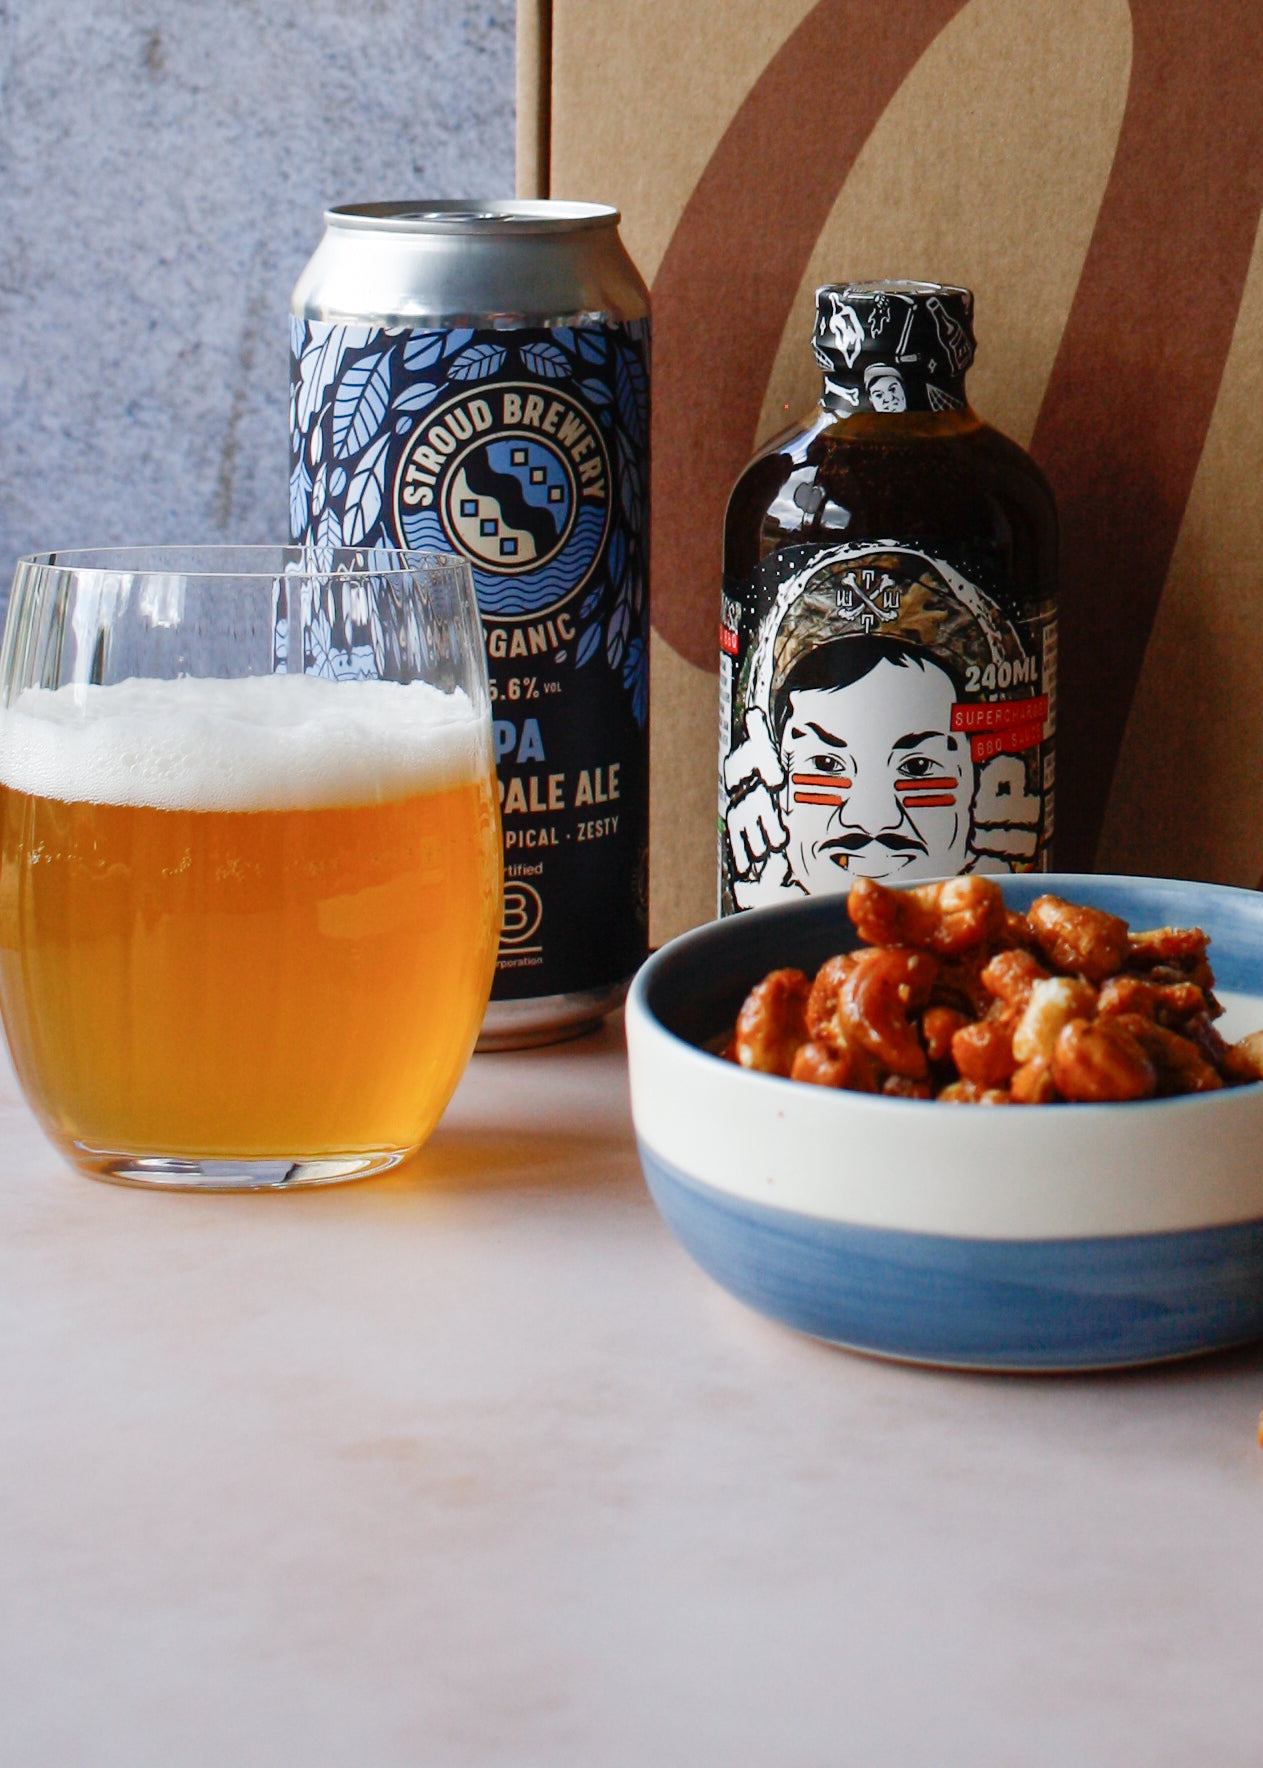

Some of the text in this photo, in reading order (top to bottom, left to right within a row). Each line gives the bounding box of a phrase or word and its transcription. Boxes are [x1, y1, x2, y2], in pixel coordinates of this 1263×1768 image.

[403, 393, 606, 507] STROUD BREWERY
[484, 613, 576, 658] GANIC
[489, 677, 540, 701] 5.6%
[965, 656, 1039, 693] 240ML
[493, 718, 546, 763] PA
[574, 763, 621, 807] ALE
[506, 816, 619, 848] PICAL ZESTY
[504, 862, 543, 877] tified
[496, 956, 543, 969] rporation
